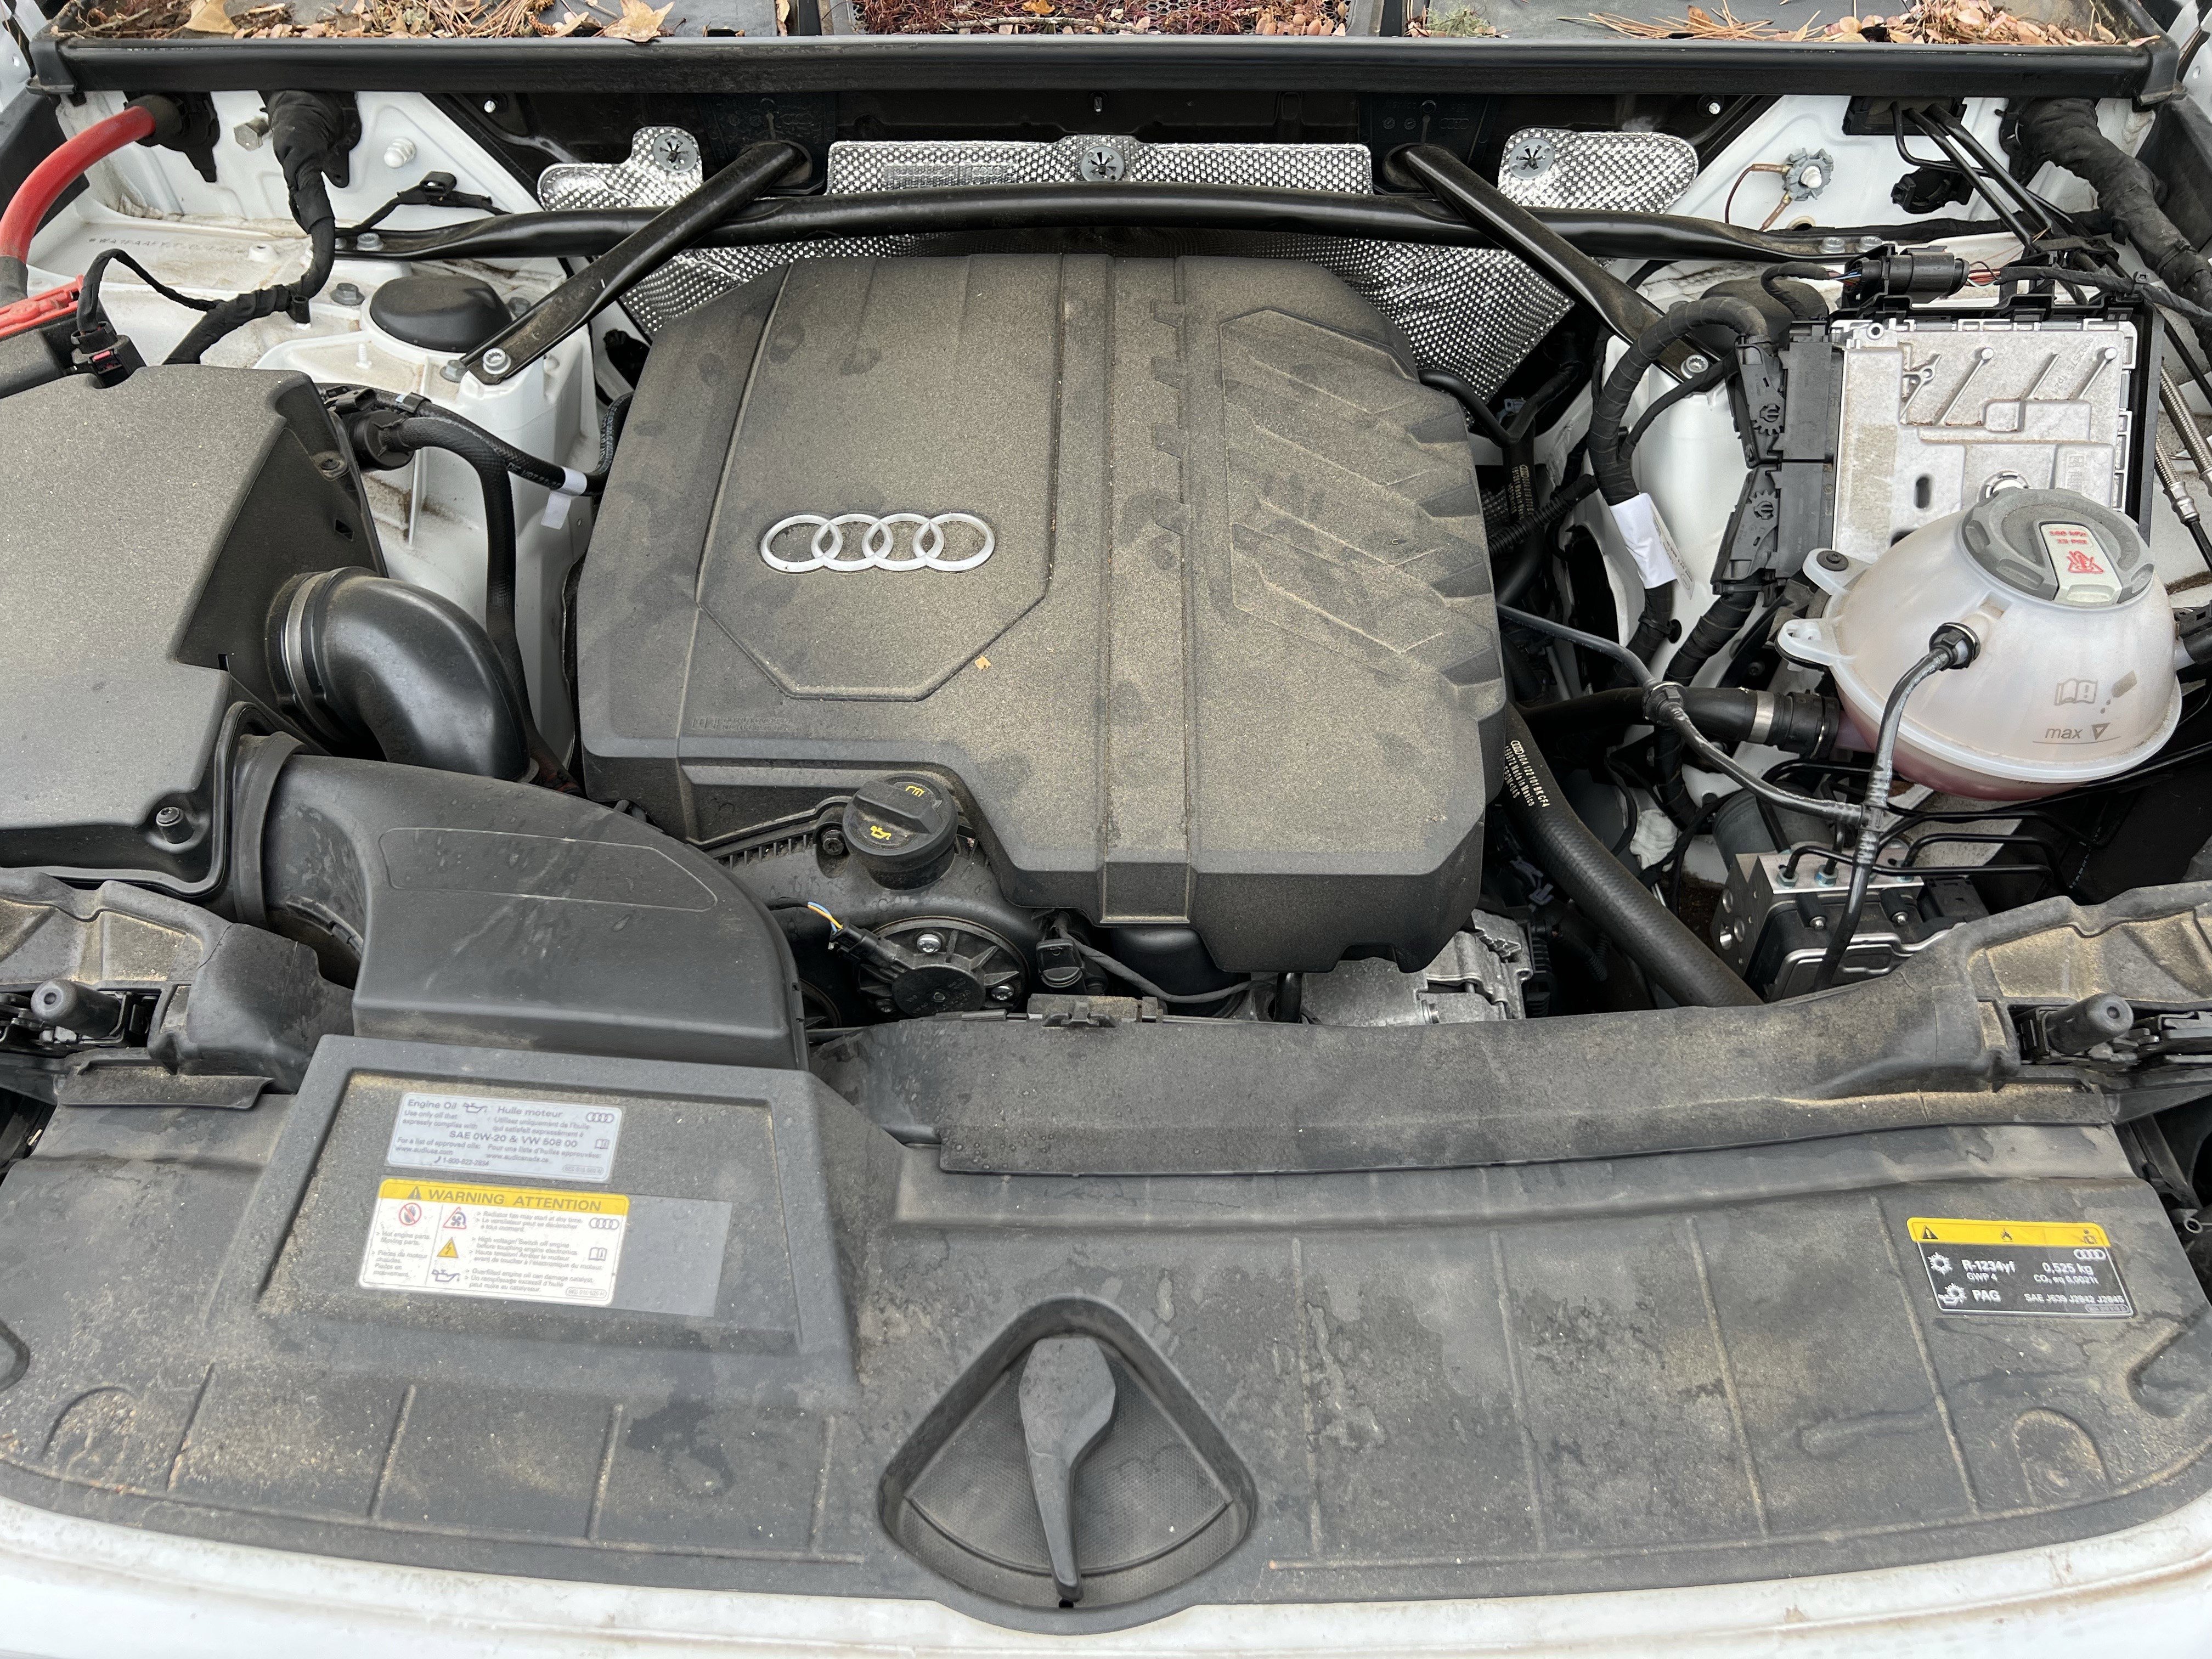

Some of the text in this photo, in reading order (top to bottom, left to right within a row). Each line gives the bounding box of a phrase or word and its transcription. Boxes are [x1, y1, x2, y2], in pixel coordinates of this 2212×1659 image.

[2045, 727, 2083, 739] max
[1523, 765, 1534, 775] 122
[1529, 776, 1539, 786] 101
[1511, 764, 1522, 781] Made
[1521, 785, 1535, 806] Mexico
[407, 1099, 440, 1109] Engine
[498, 1106, 562, 1118] Huile moteur
[402, 1118, 432, 1127] expressly
[433, 1120, 462, 1129] complies
[519, 1118, 558, 1127] uniquement
[435, 1140, 465, 1149] approved
[449, 1131, 470, 1139] SAE
[473, 1132, 506, 1142] 0W-20
[521, 1136, 540, 1144] VW
[543, 1137, 562, 1146] 508
[565, 1139, 577, 1147] 00
[428, 1189, 602, 1211] WARNING ATTENTION
[1962, 1259, 2017, 1275] R-1234yf
[2042, 1262, 2094, 1276] 0,525 kg
[544, 1273, 568, 1281] damage
[1972, 1290, 2002, 1301] PAG
[2024, 1293, 2044, 1302] SAE
[2045, 1294, 2067, 1303] J639
